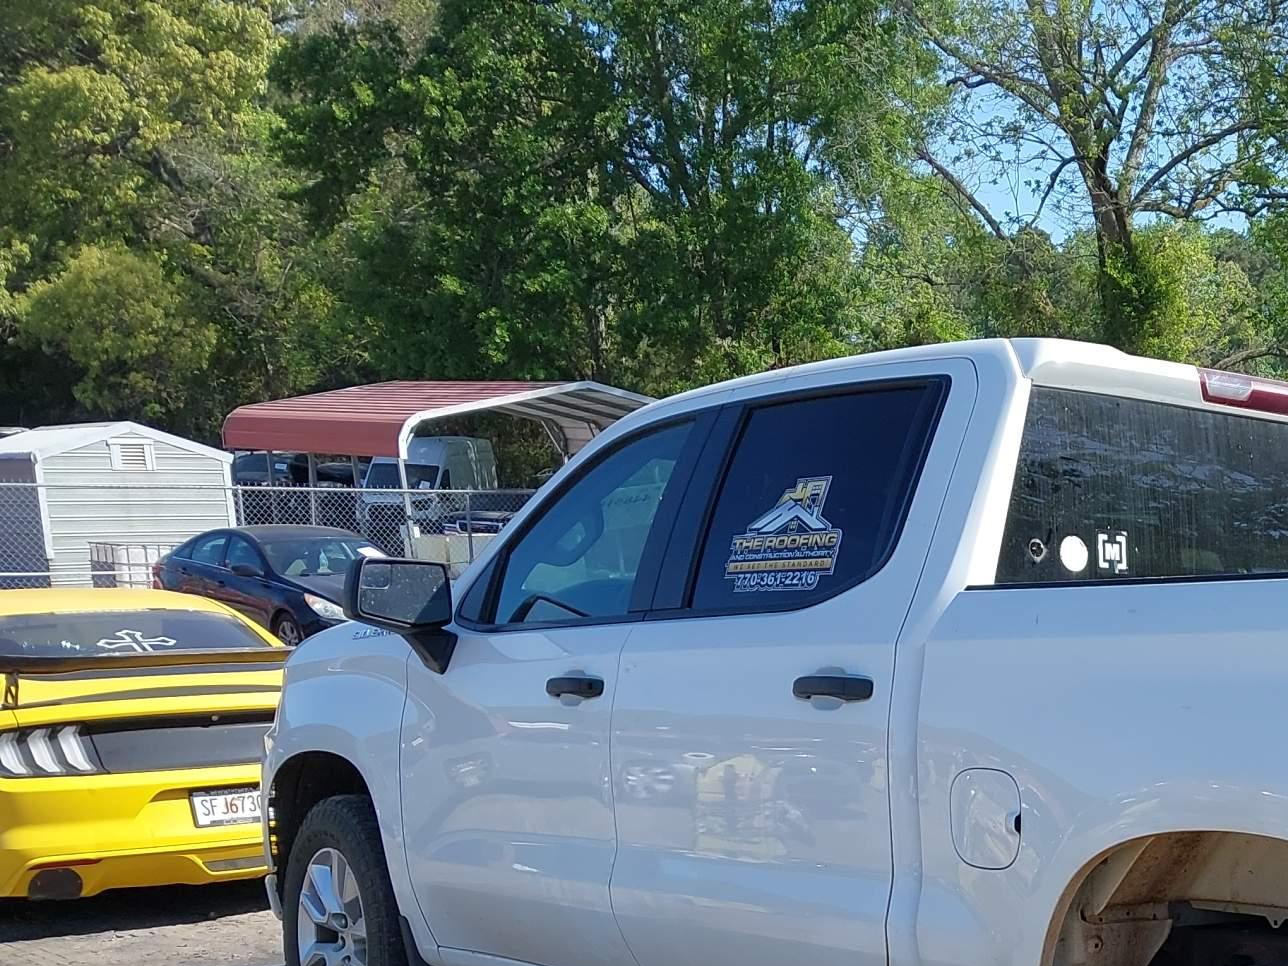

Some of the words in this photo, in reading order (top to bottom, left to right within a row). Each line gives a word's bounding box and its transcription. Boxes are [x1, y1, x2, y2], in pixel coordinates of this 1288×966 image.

[735, 537, 764, 551] THE
[765, 533, 838, 549] ROOFING
[745, 551, 795, 560] CONSTRUCTION
[795, 550, 835, 558] AUTHORITY
[782, 560, 825, 569] STANDARD
[737, 571, 815, 586] 770-361-2216
